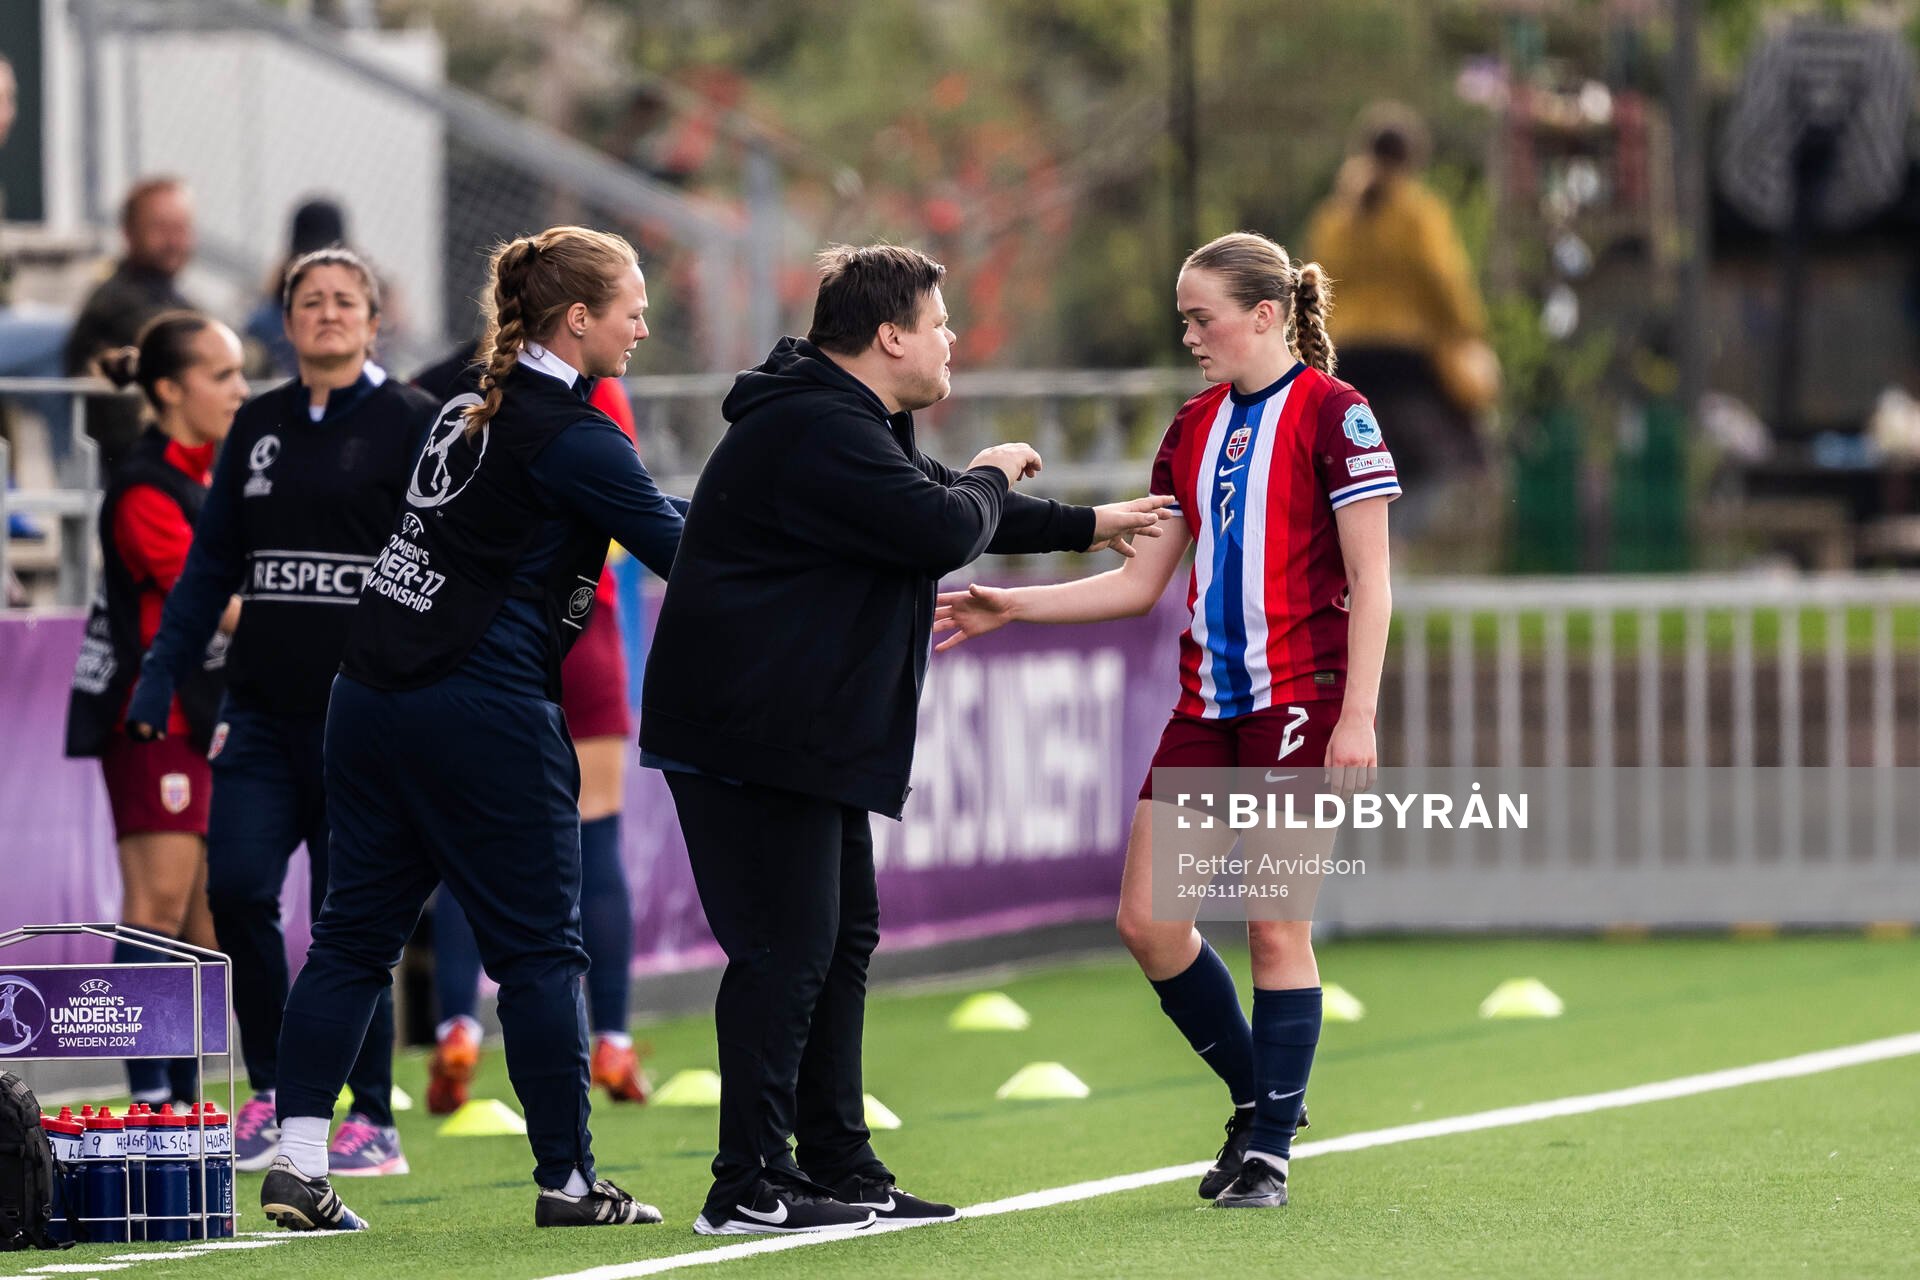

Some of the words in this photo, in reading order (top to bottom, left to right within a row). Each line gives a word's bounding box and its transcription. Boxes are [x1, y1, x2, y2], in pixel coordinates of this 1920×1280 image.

[1219, 482, 1236, 538] 2
[388, 533, 430, 566] OMEN'S
[253, 560, 373, 595] RESPECT
[1278, 706, 1309, 761] 2
[81, 981, 110, 993] UEFA
[68, 996, 125, 1007] WOMEN'S
[50, 1006, 143, 1023] UNDER-17
[50, 1023, 143, 1034] CHAMPIONSHIP
[58, 1037, 107, 1048] SWEDEN
[109, 1036, 137, 1047] 2024
